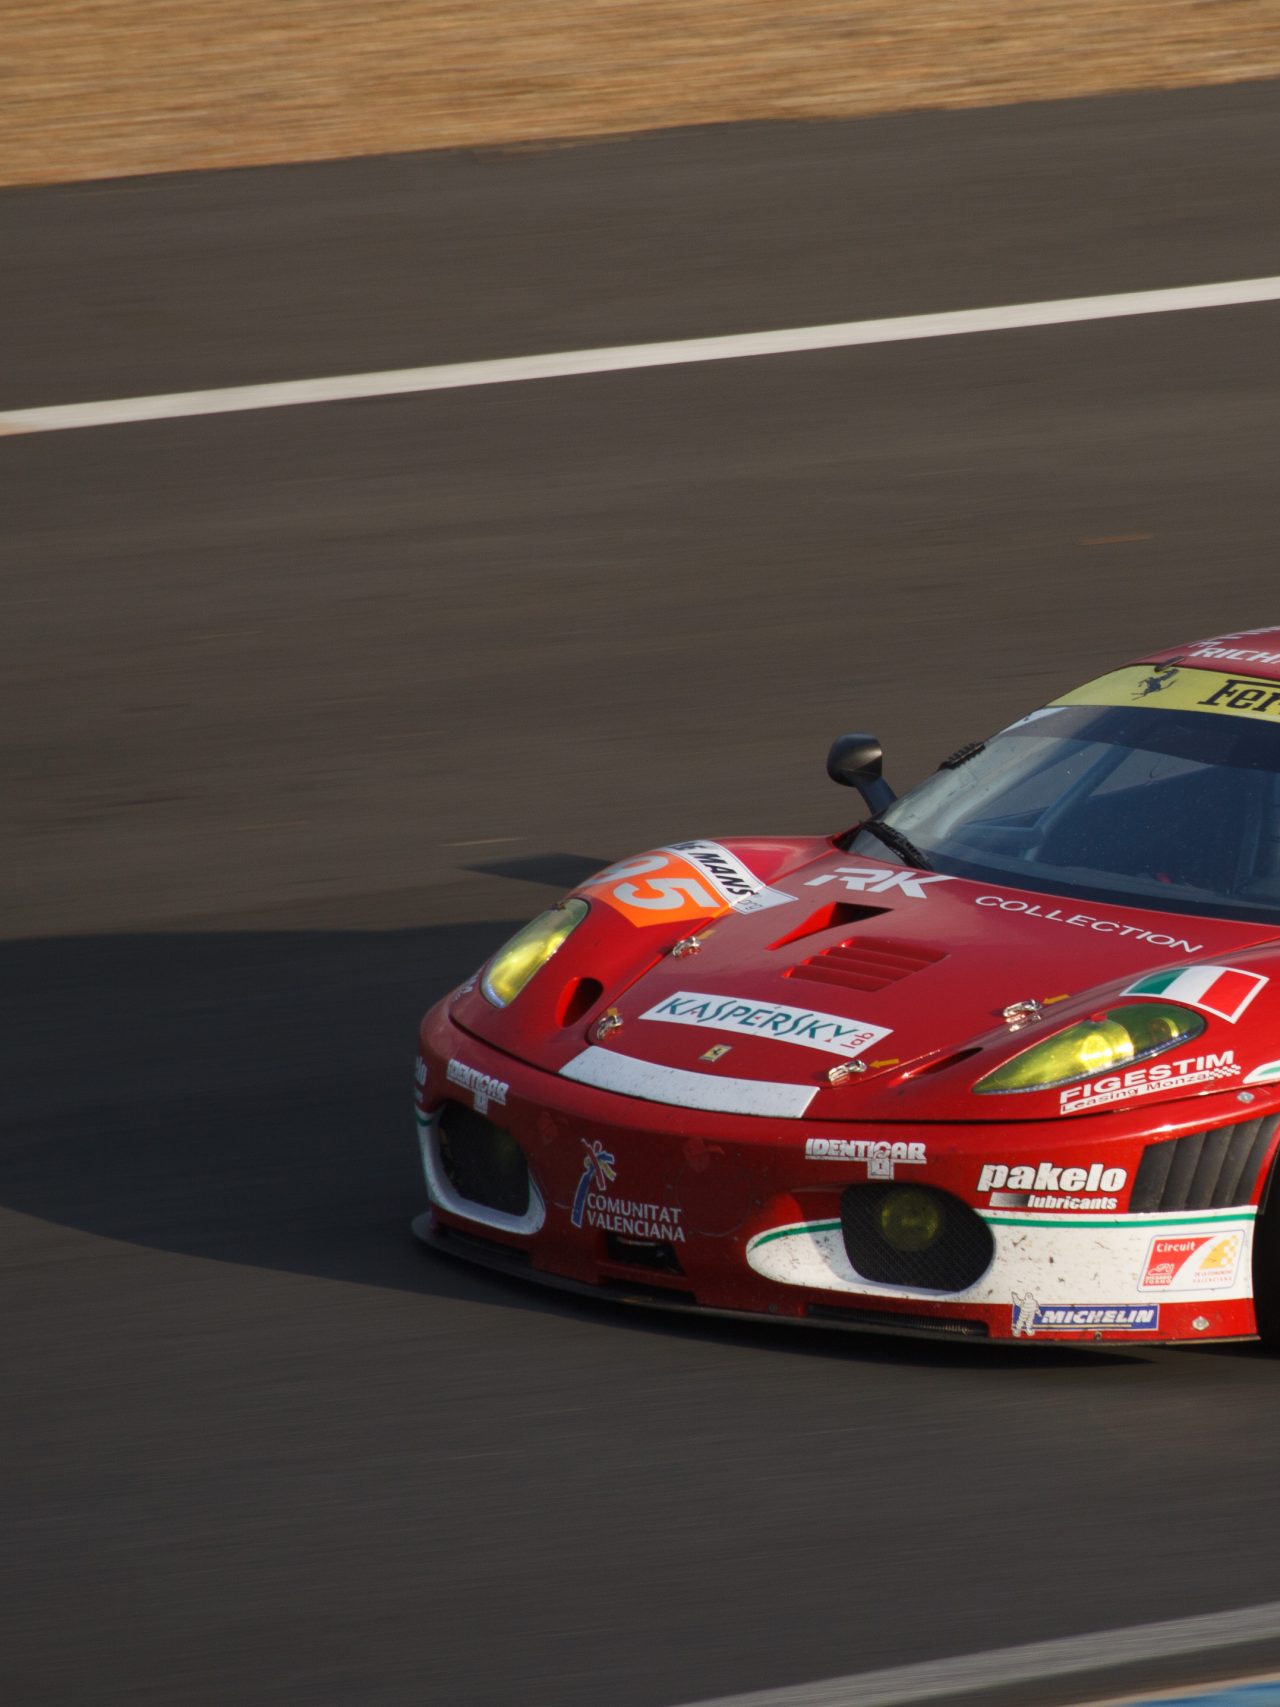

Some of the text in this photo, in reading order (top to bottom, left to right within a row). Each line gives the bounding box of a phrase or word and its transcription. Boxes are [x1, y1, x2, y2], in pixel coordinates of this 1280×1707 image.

[687, 852, 756, 896] MANS
[803, 867, 959, 899] RK
[975, 895, 1204, 954] COLLECTION
[655, 998, 875, 1050] KASPERSKY lab
[1060, 1050, 1234, 1104] FIGESTIM
[1062, 1074, 1208, 1112] Leasing Monza
[805, 1138, 927, 1161] IDENTICAR
[976, 1163, 1128, 1192] pakelo
[587, 1193, 682, 1223] COMUNITAT
[1027, 1194, 1118, 1210] lubricants
[587, 1210, 686, 1242] VALENCIANA
[1156, 1241, 1196, 1253] Circuit
[1041, 1309, 1154, 1324] MICHELIN
